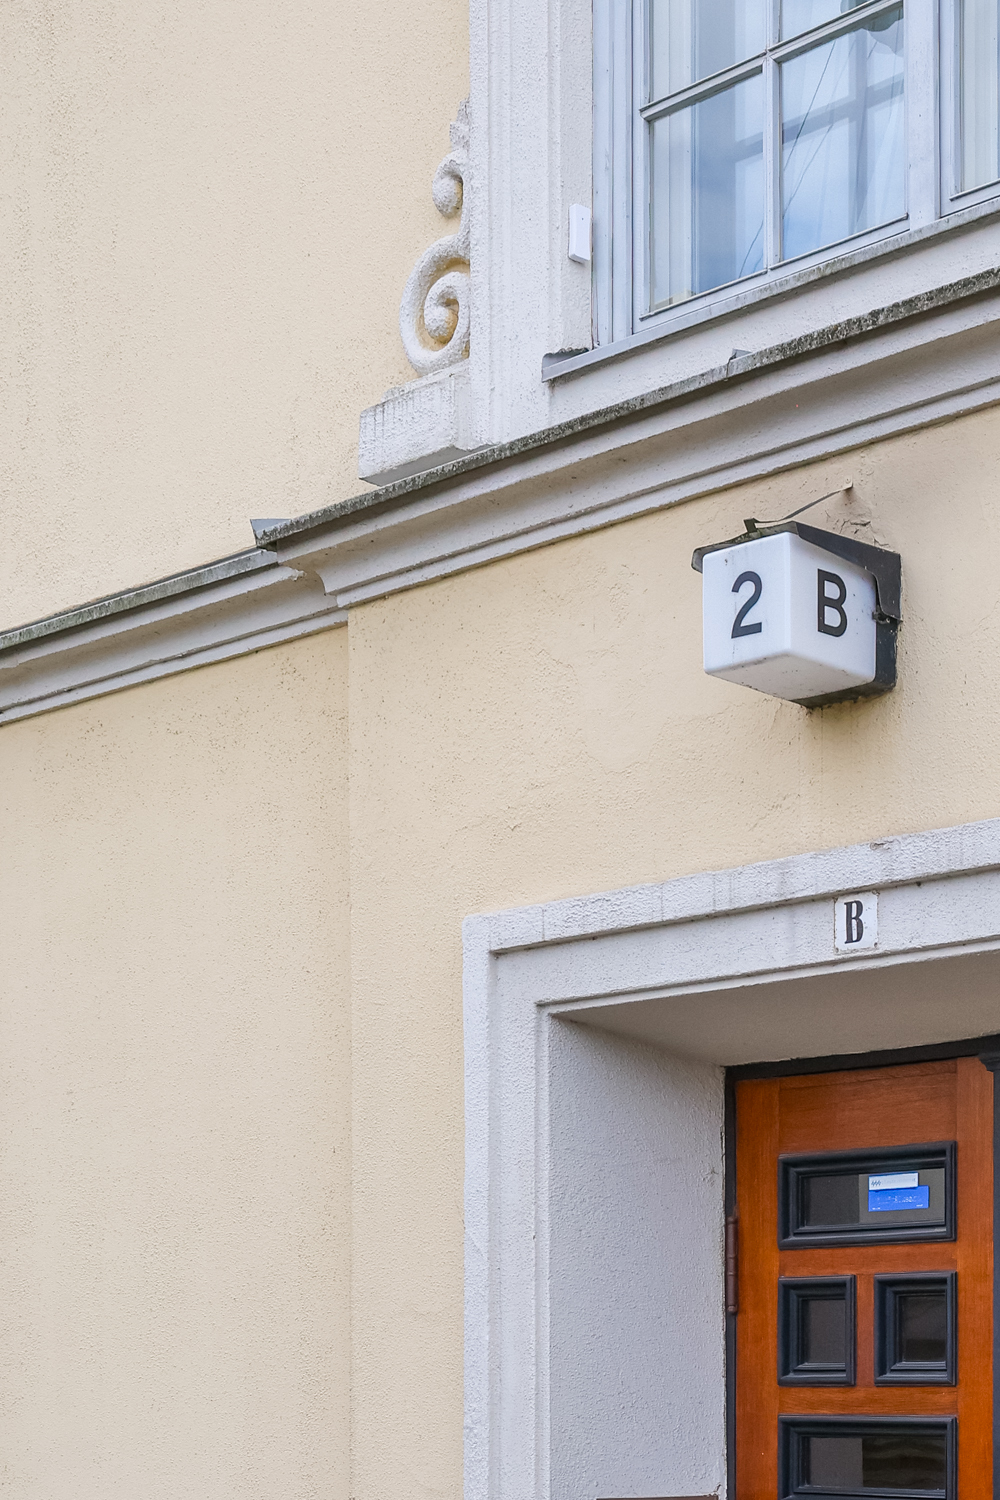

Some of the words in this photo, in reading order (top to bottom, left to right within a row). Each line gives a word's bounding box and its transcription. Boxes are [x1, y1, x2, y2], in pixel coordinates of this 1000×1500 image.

[731, 570, 763, 639] 2
[817, 568, 848, 638] B
[843, 899, 864, 945] B
